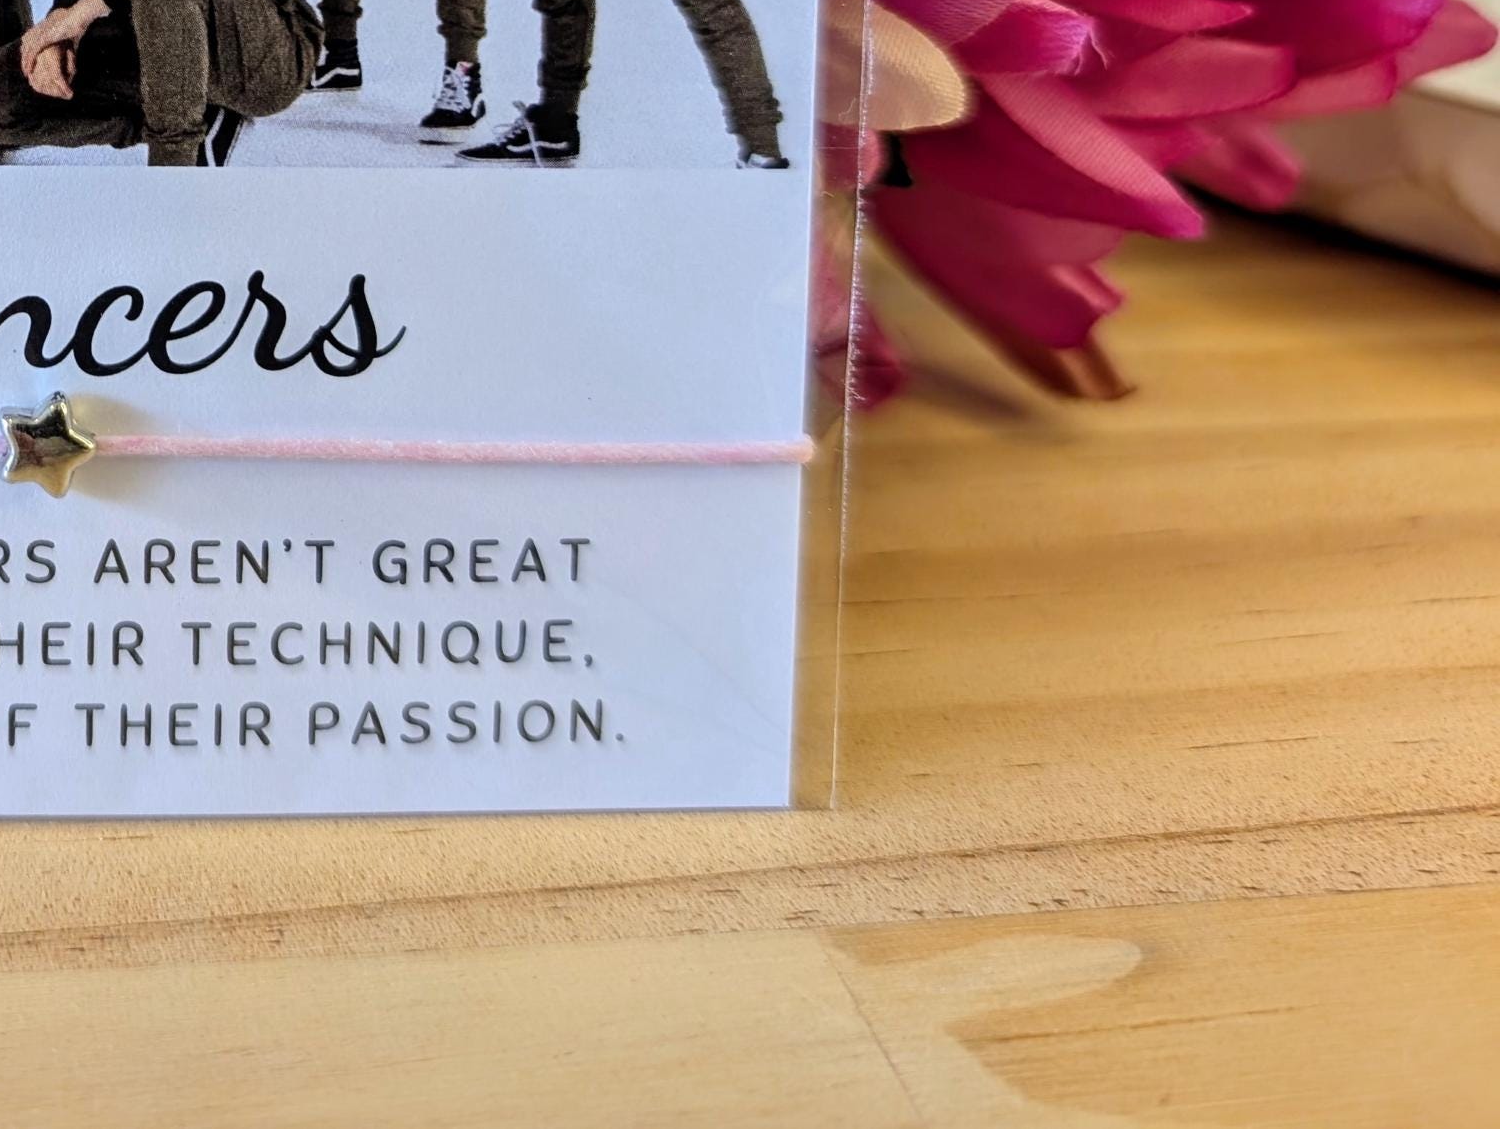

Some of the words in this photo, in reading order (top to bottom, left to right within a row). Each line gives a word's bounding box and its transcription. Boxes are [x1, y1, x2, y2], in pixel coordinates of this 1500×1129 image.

[93, 538, 336, 586] AREN'T
[371, 537, 591, 586] GREAT
[180, 619, 594, 669] TECHNIQUE,
[74, 701, 271, 750] THEIR
[308, 699, 625, 747] PASSION.
